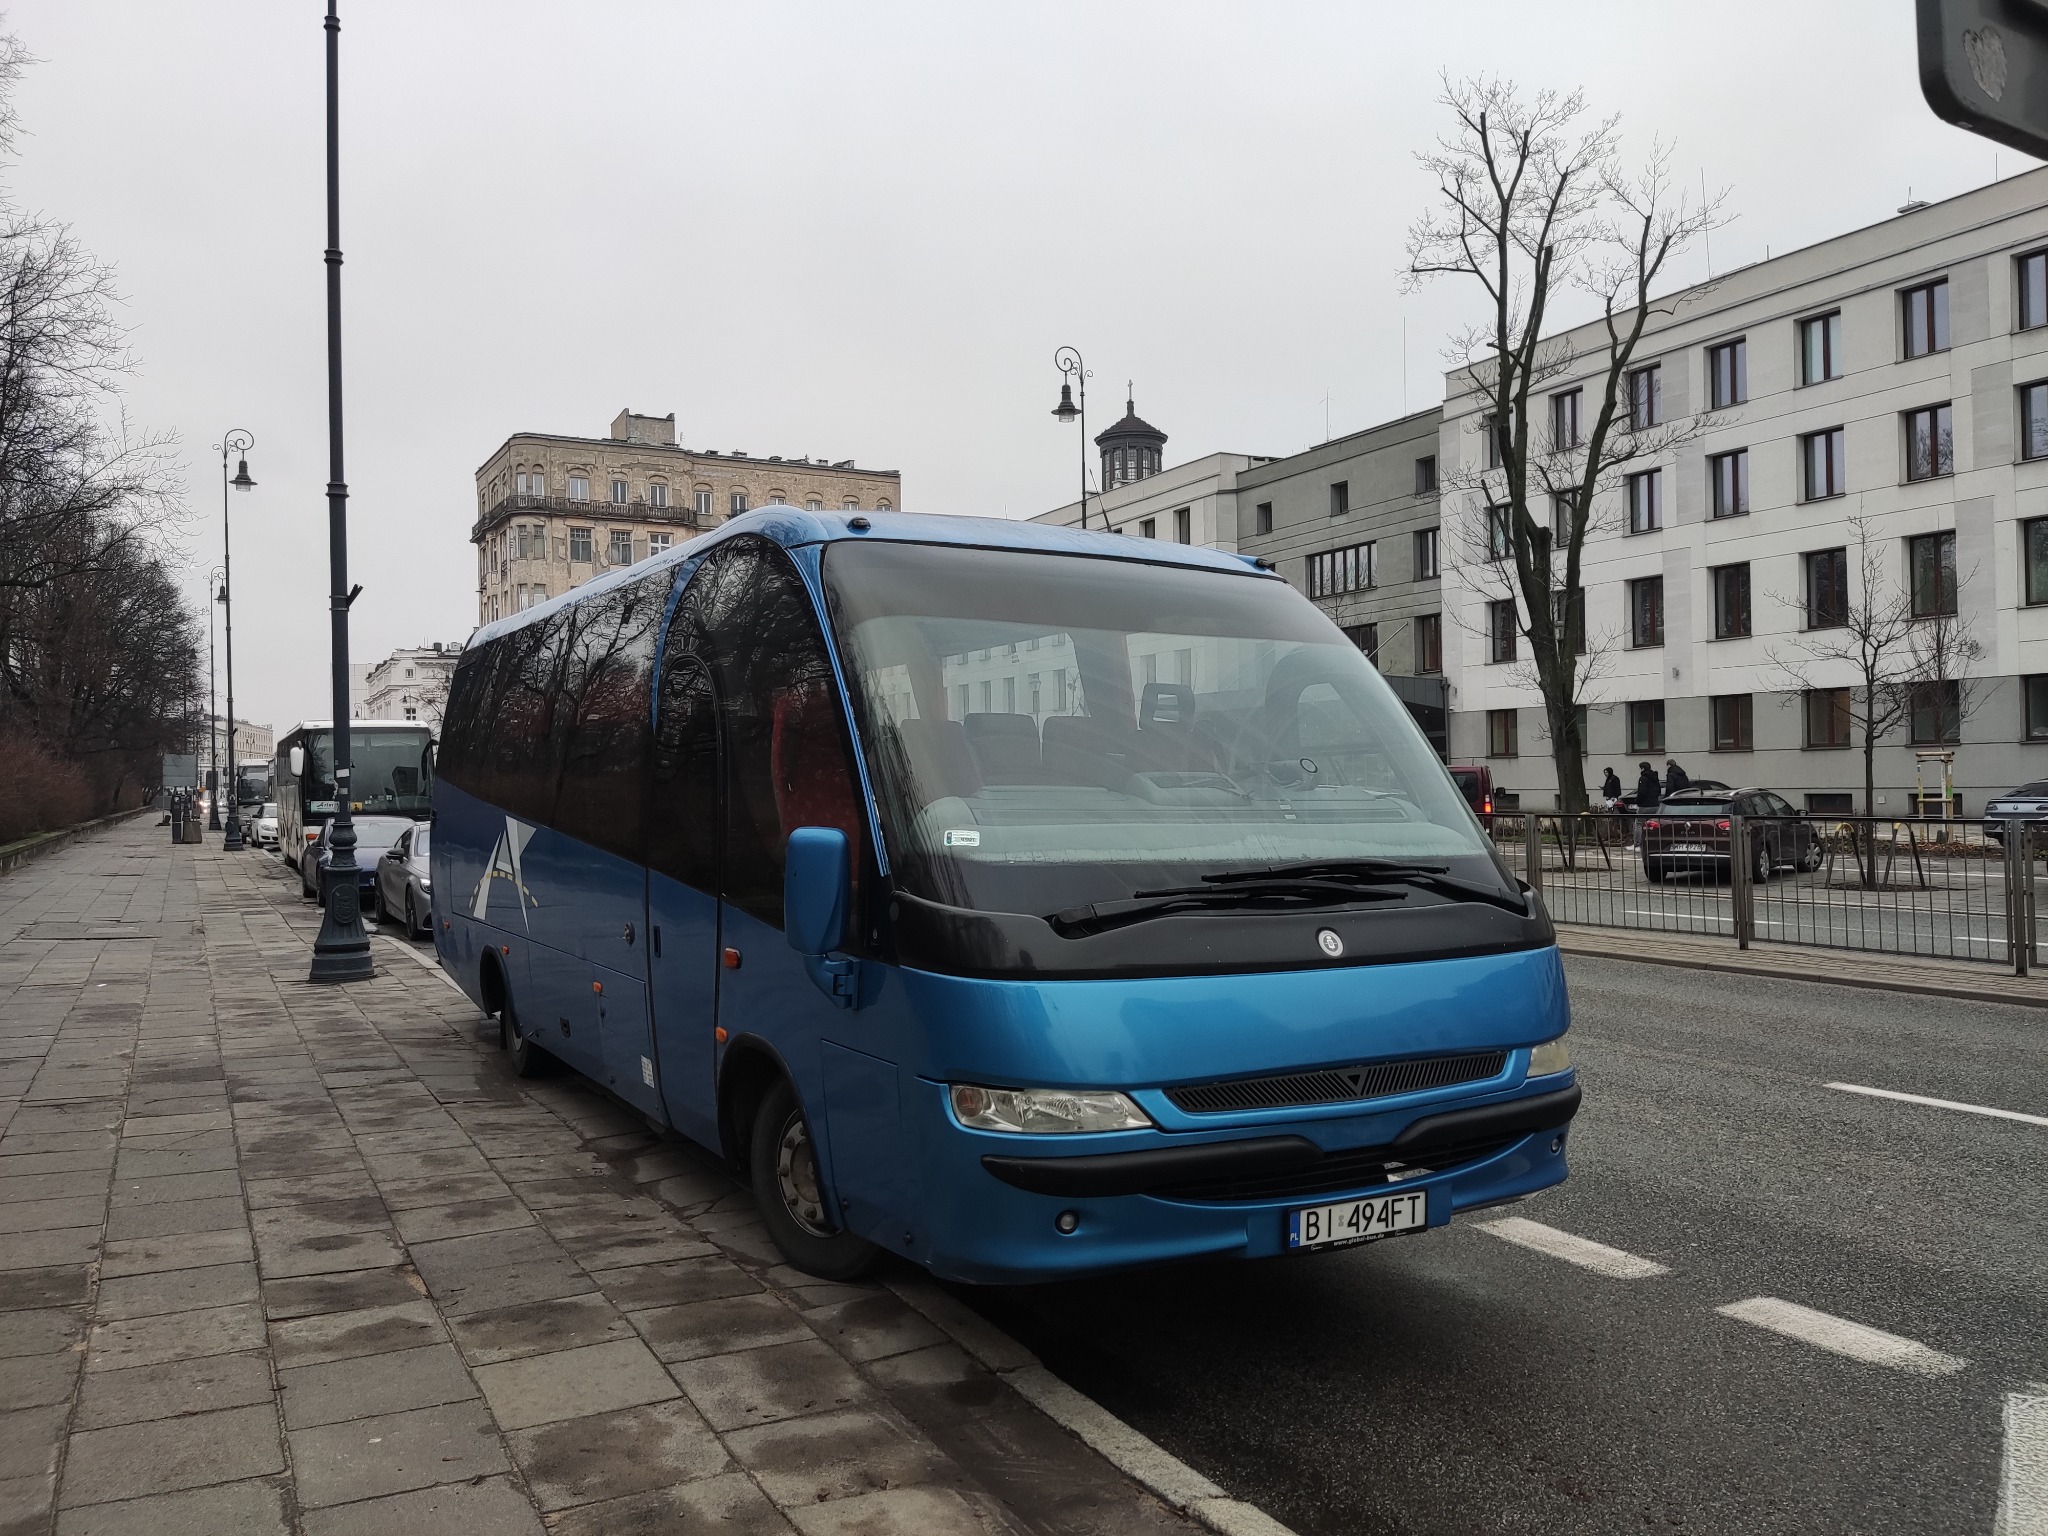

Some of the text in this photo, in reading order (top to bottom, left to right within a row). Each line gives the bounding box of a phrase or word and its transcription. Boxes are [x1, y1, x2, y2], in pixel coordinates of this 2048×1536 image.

[1306, 1195, 1420, 1241] BI 494FT
[1290, 1232, 1299, 1242] PL
[1333, 1233, 1385, 1246] www.global-bus.de
